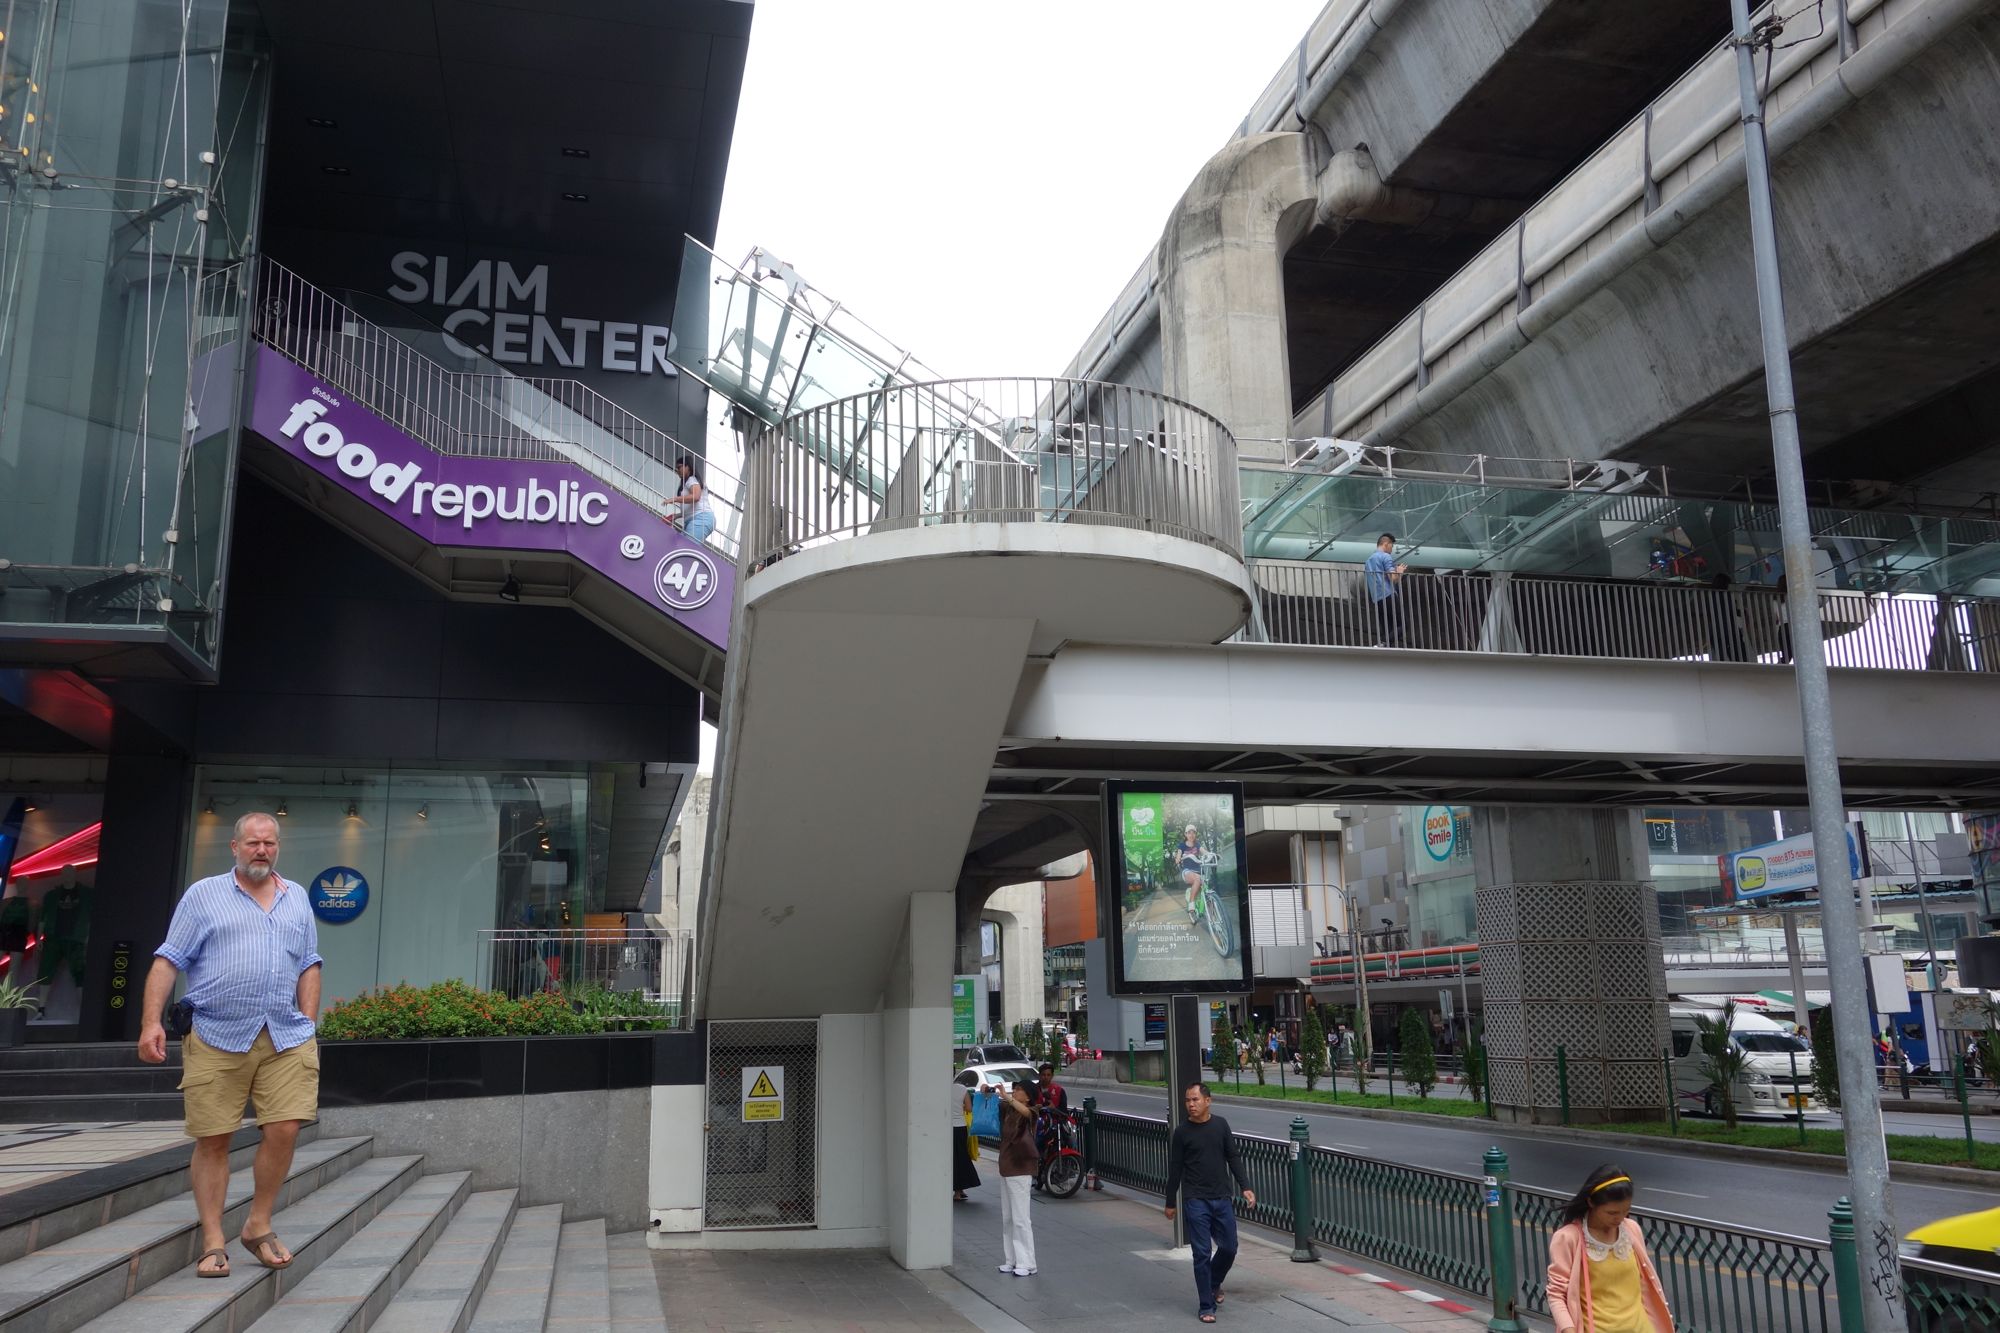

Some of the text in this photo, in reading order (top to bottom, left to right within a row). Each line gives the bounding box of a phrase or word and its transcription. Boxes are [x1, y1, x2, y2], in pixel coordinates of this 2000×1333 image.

[387, 251, 549, 314] SIAM
[442, 309, 679, 377] CENTER
[280, 399, 708, 599] food republic @ 4/F
[1427, 815, 1450, 830] BOOK
[1428, 829, 1452, 846] Smile
[318, 899, 357, 908] adidas
